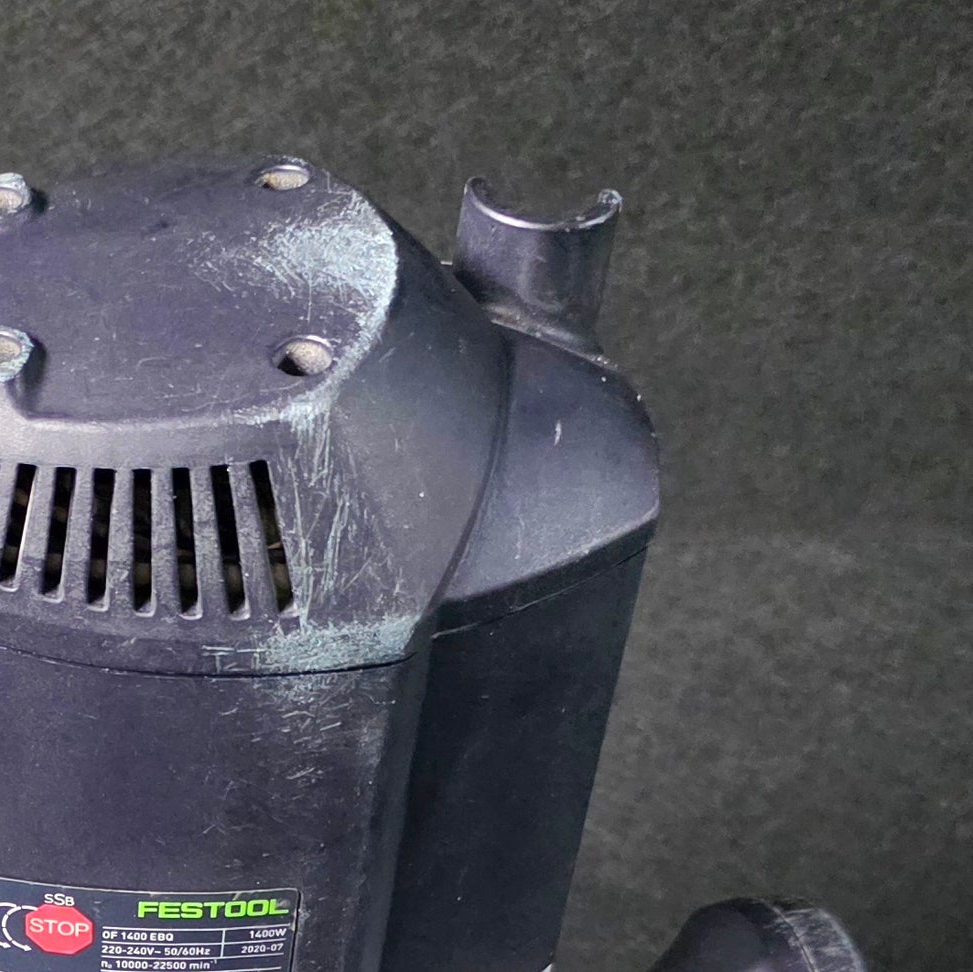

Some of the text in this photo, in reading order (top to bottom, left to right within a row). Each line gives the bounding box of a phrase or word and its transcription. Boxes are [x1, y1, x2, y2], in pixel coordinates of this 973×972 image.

[137, 899, 289, 918] FESTOOL
[29, 919, 90, 937] STOP
[249, 928, 287, 939] 1400W
[101, 930, 174, 942] OF 1400 EBQ
[164, 946, 211, 956] 50/60Hz
[241, 943, 284, 954] 2020-07
[115, 961, 187, 970] 10000-22500
